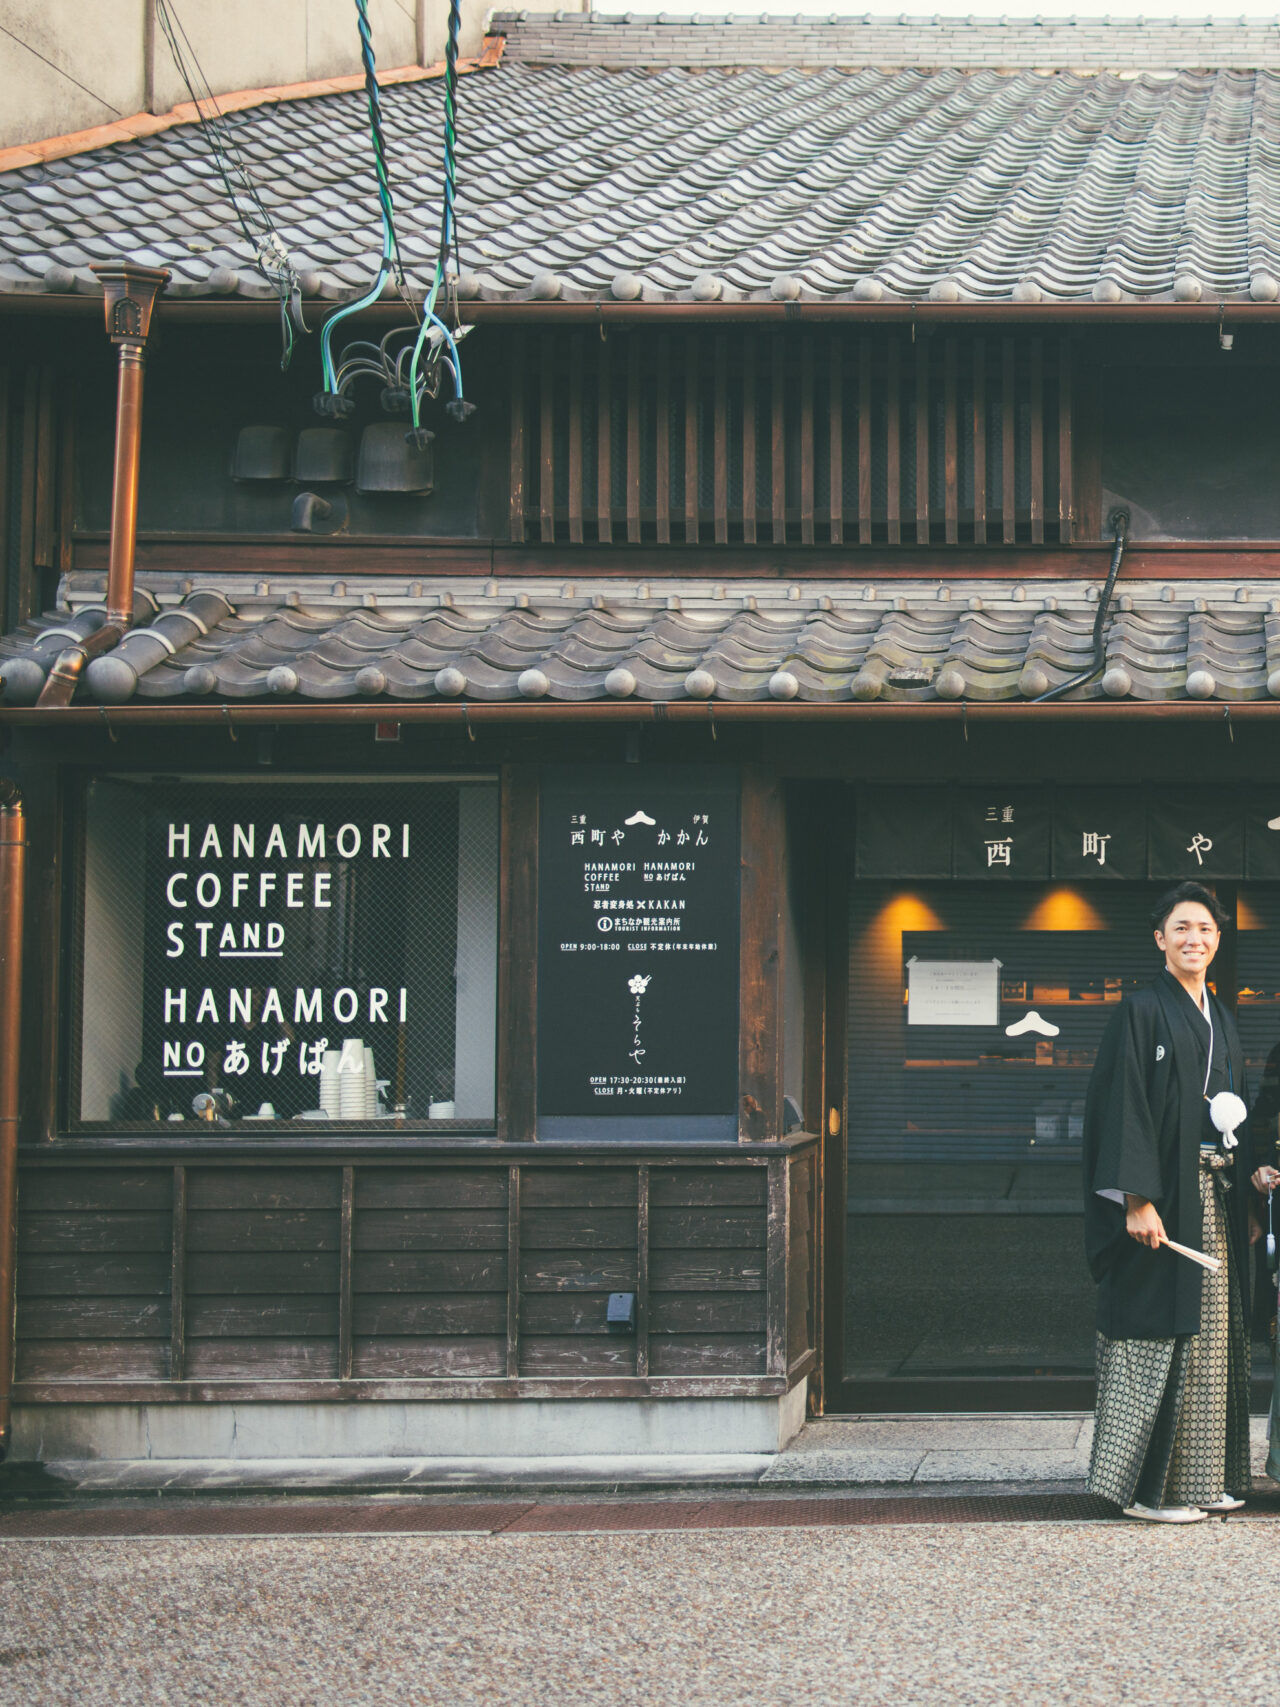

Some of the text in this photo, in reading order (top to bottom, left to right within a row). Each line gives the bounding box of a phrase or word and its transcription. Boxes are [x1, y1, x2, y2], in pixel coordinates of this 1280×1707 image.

[570, 814, 587, 825] 三重
[693, 814, 709, 825] 伊賀
[985, 805, 1014, 823] 三重
[168, 823, 410, 859] HANAMORI
[570, 829, 709, 847] 西町や かかん
[584, 862, 636, 872] HANAMORI
[643, 862, 695, 871] HANAMORI
[584, 872, 620, 882] COFFEE
[166, 872, 332, 908] COFFEE
[584, 883, 610, 892] STAND
[166, 922, 285, 958] STAND
[560, 943, 578, 951] OPEN
[579, 943, 621, 951] 9:00-18:00
[164, 987, 407, 1023] HANAMORI
[163, 1037, 364, 1076] NO あげぱん
[589, 1076, 607, 1085] OPEN
